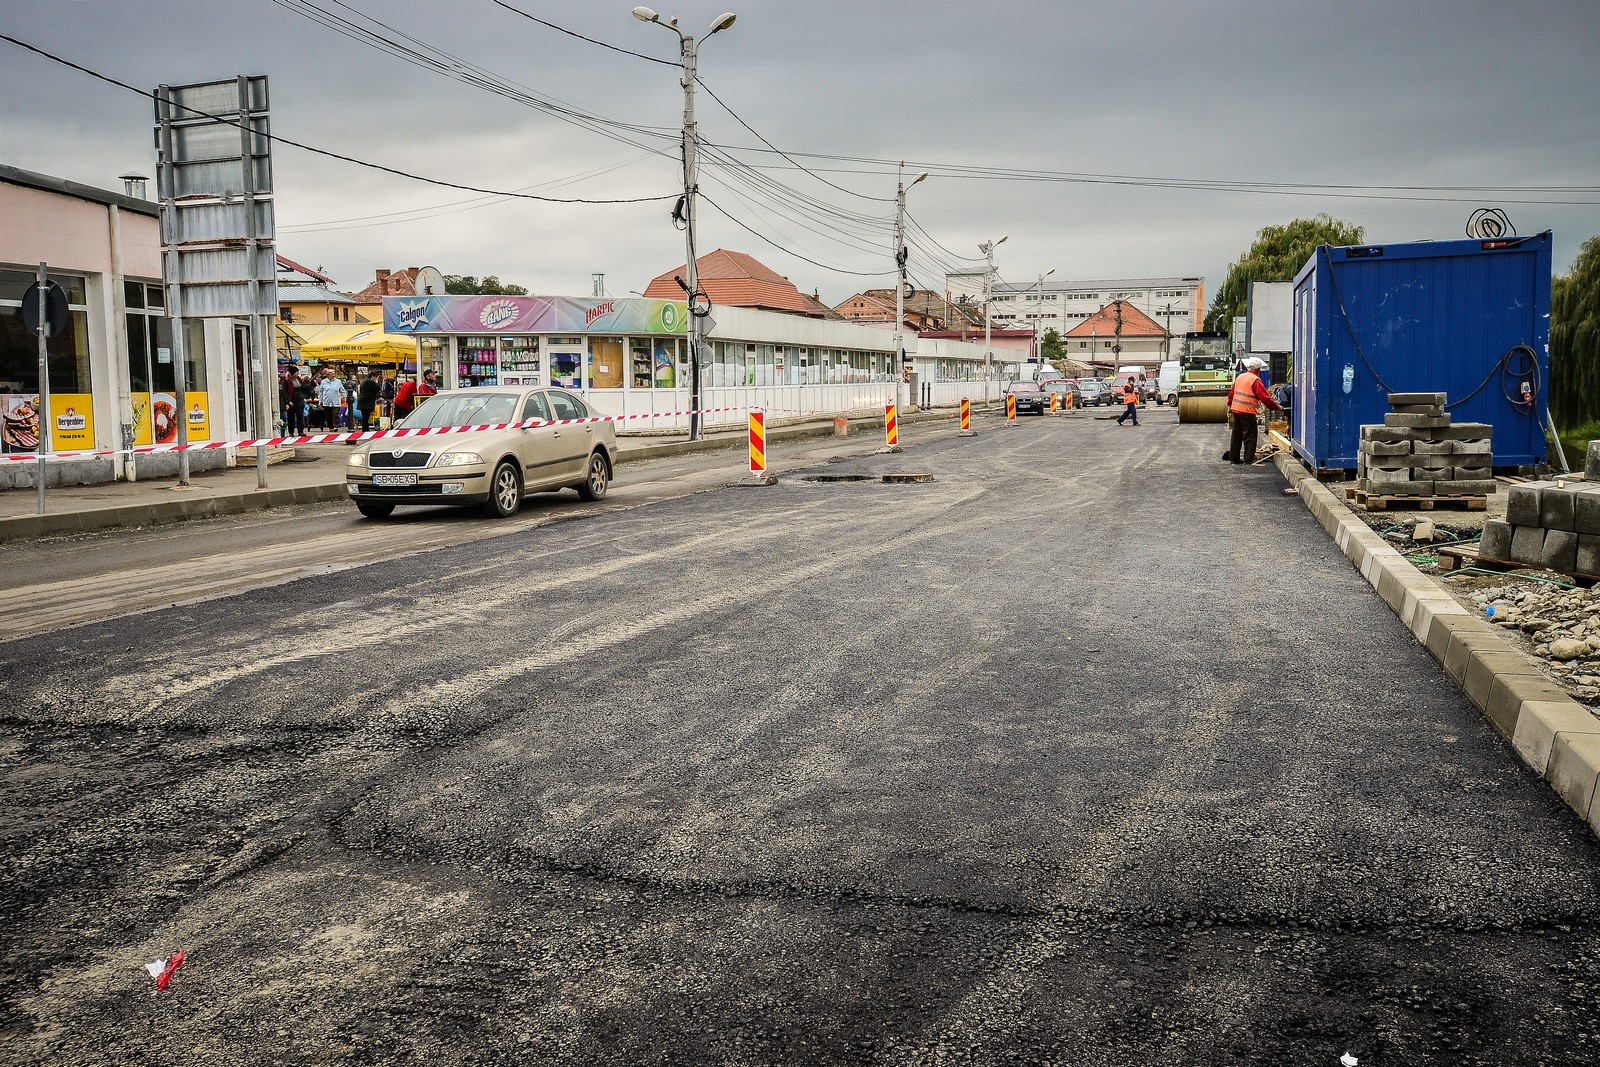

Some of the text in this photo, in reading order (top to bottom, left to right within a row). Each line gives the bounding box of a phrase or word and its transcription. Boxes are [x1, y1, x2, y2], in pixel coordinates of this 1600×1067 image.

[400, 306, 425, 323] Calgon
[487, 307, 512, 325] BANG
[585, 302, 615, 324] HARPIC
